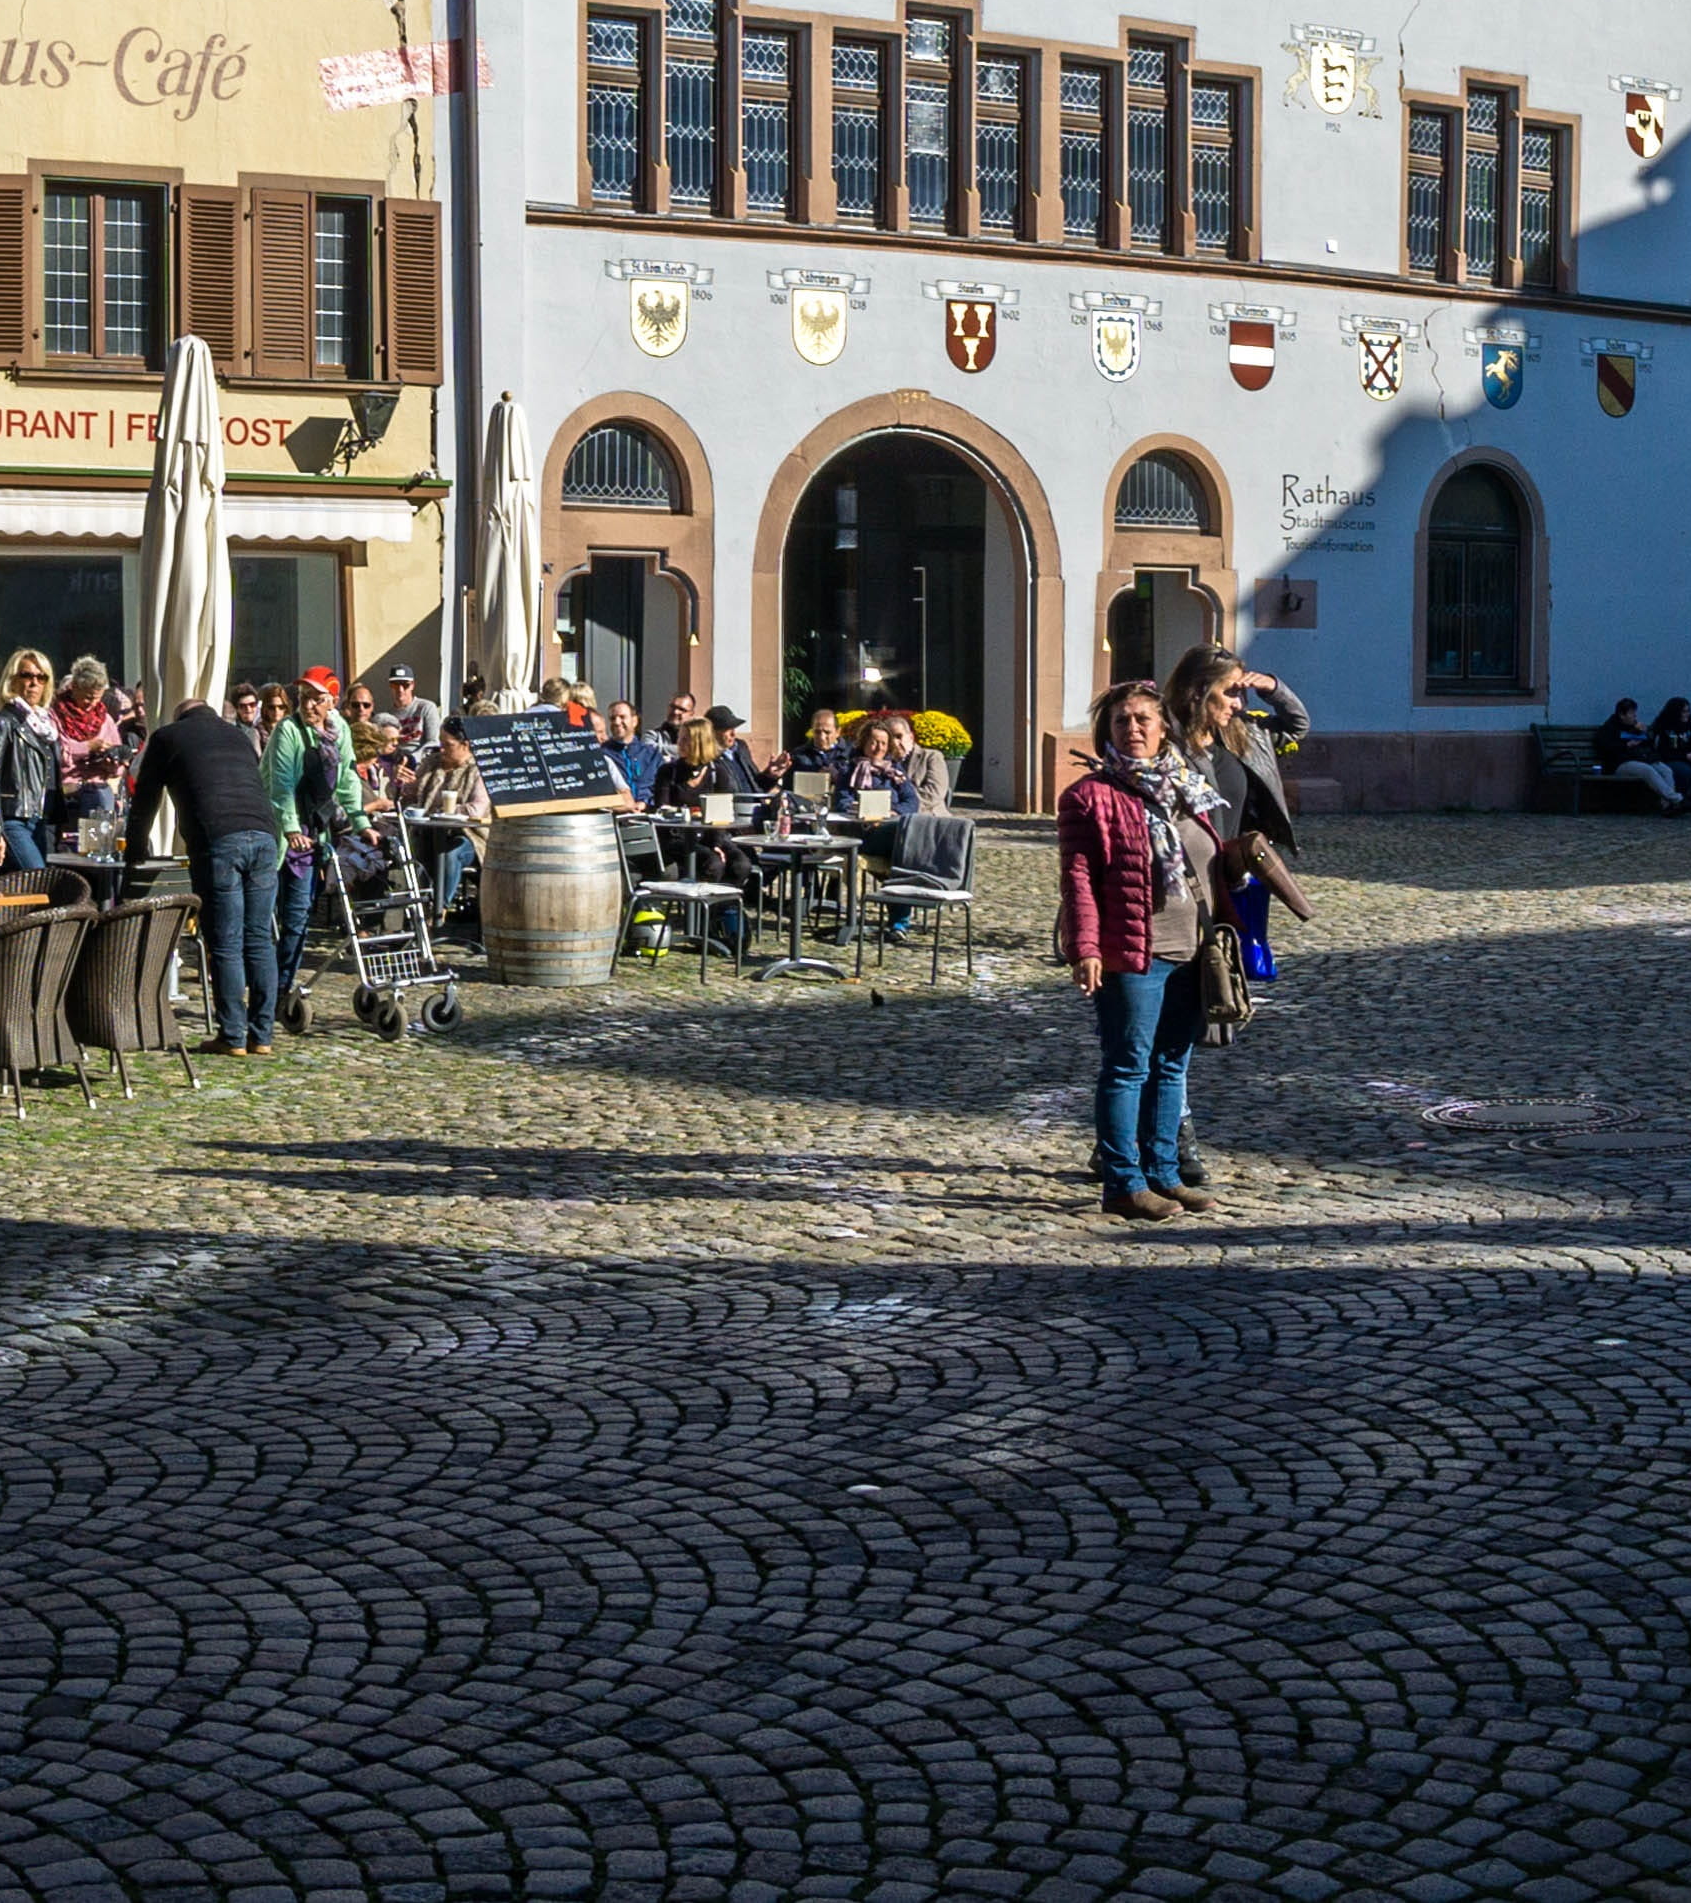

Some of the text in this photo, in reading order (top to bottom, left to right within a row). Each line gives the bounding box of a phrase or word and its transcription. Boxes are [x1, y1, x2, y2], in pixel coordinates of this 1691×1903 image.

[127, 413, 292, 447] FEOST
[1282, 474, 1376, 507] Rathaus
[1280, 509, 1375, 531] Stadtmuseum
[1282, 536, 1374, 553] Touristinformation
